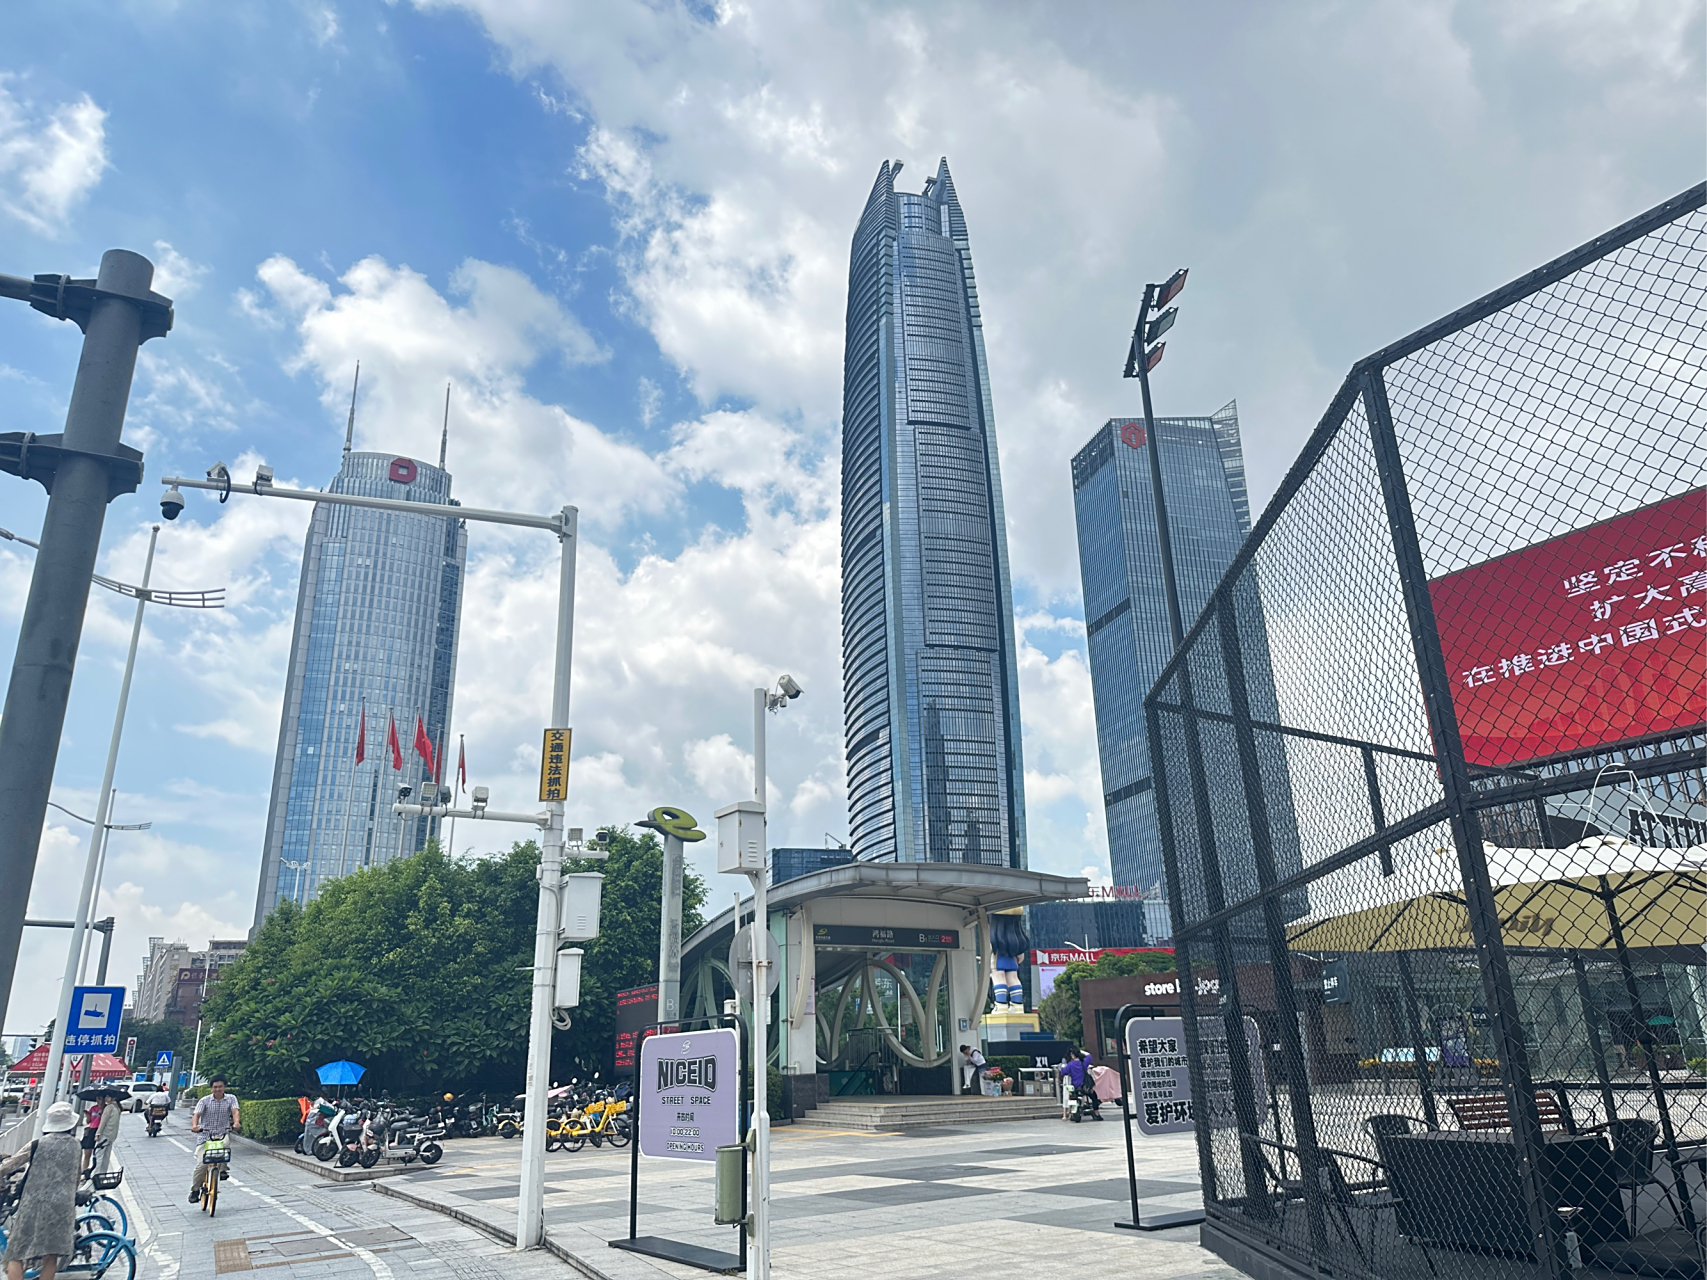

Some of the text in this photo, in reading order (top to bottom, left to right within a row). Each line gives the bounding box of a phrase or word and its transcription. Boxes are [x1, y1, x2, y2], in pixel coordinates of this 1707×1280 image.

[1462, 606, 1707, 688] 在推进中国式
[546, 729, 565, 800] 交通违法抓拍
[1144, 982, 1175, 996] store
[65, 1034, 116, 1046] 违停抓拍
[1137, 1038, 1178, 1055] 希望大家
[656, 1054, 717, 1093] NICEID
[661, 1096, 712, 1105] STREET SPACE
